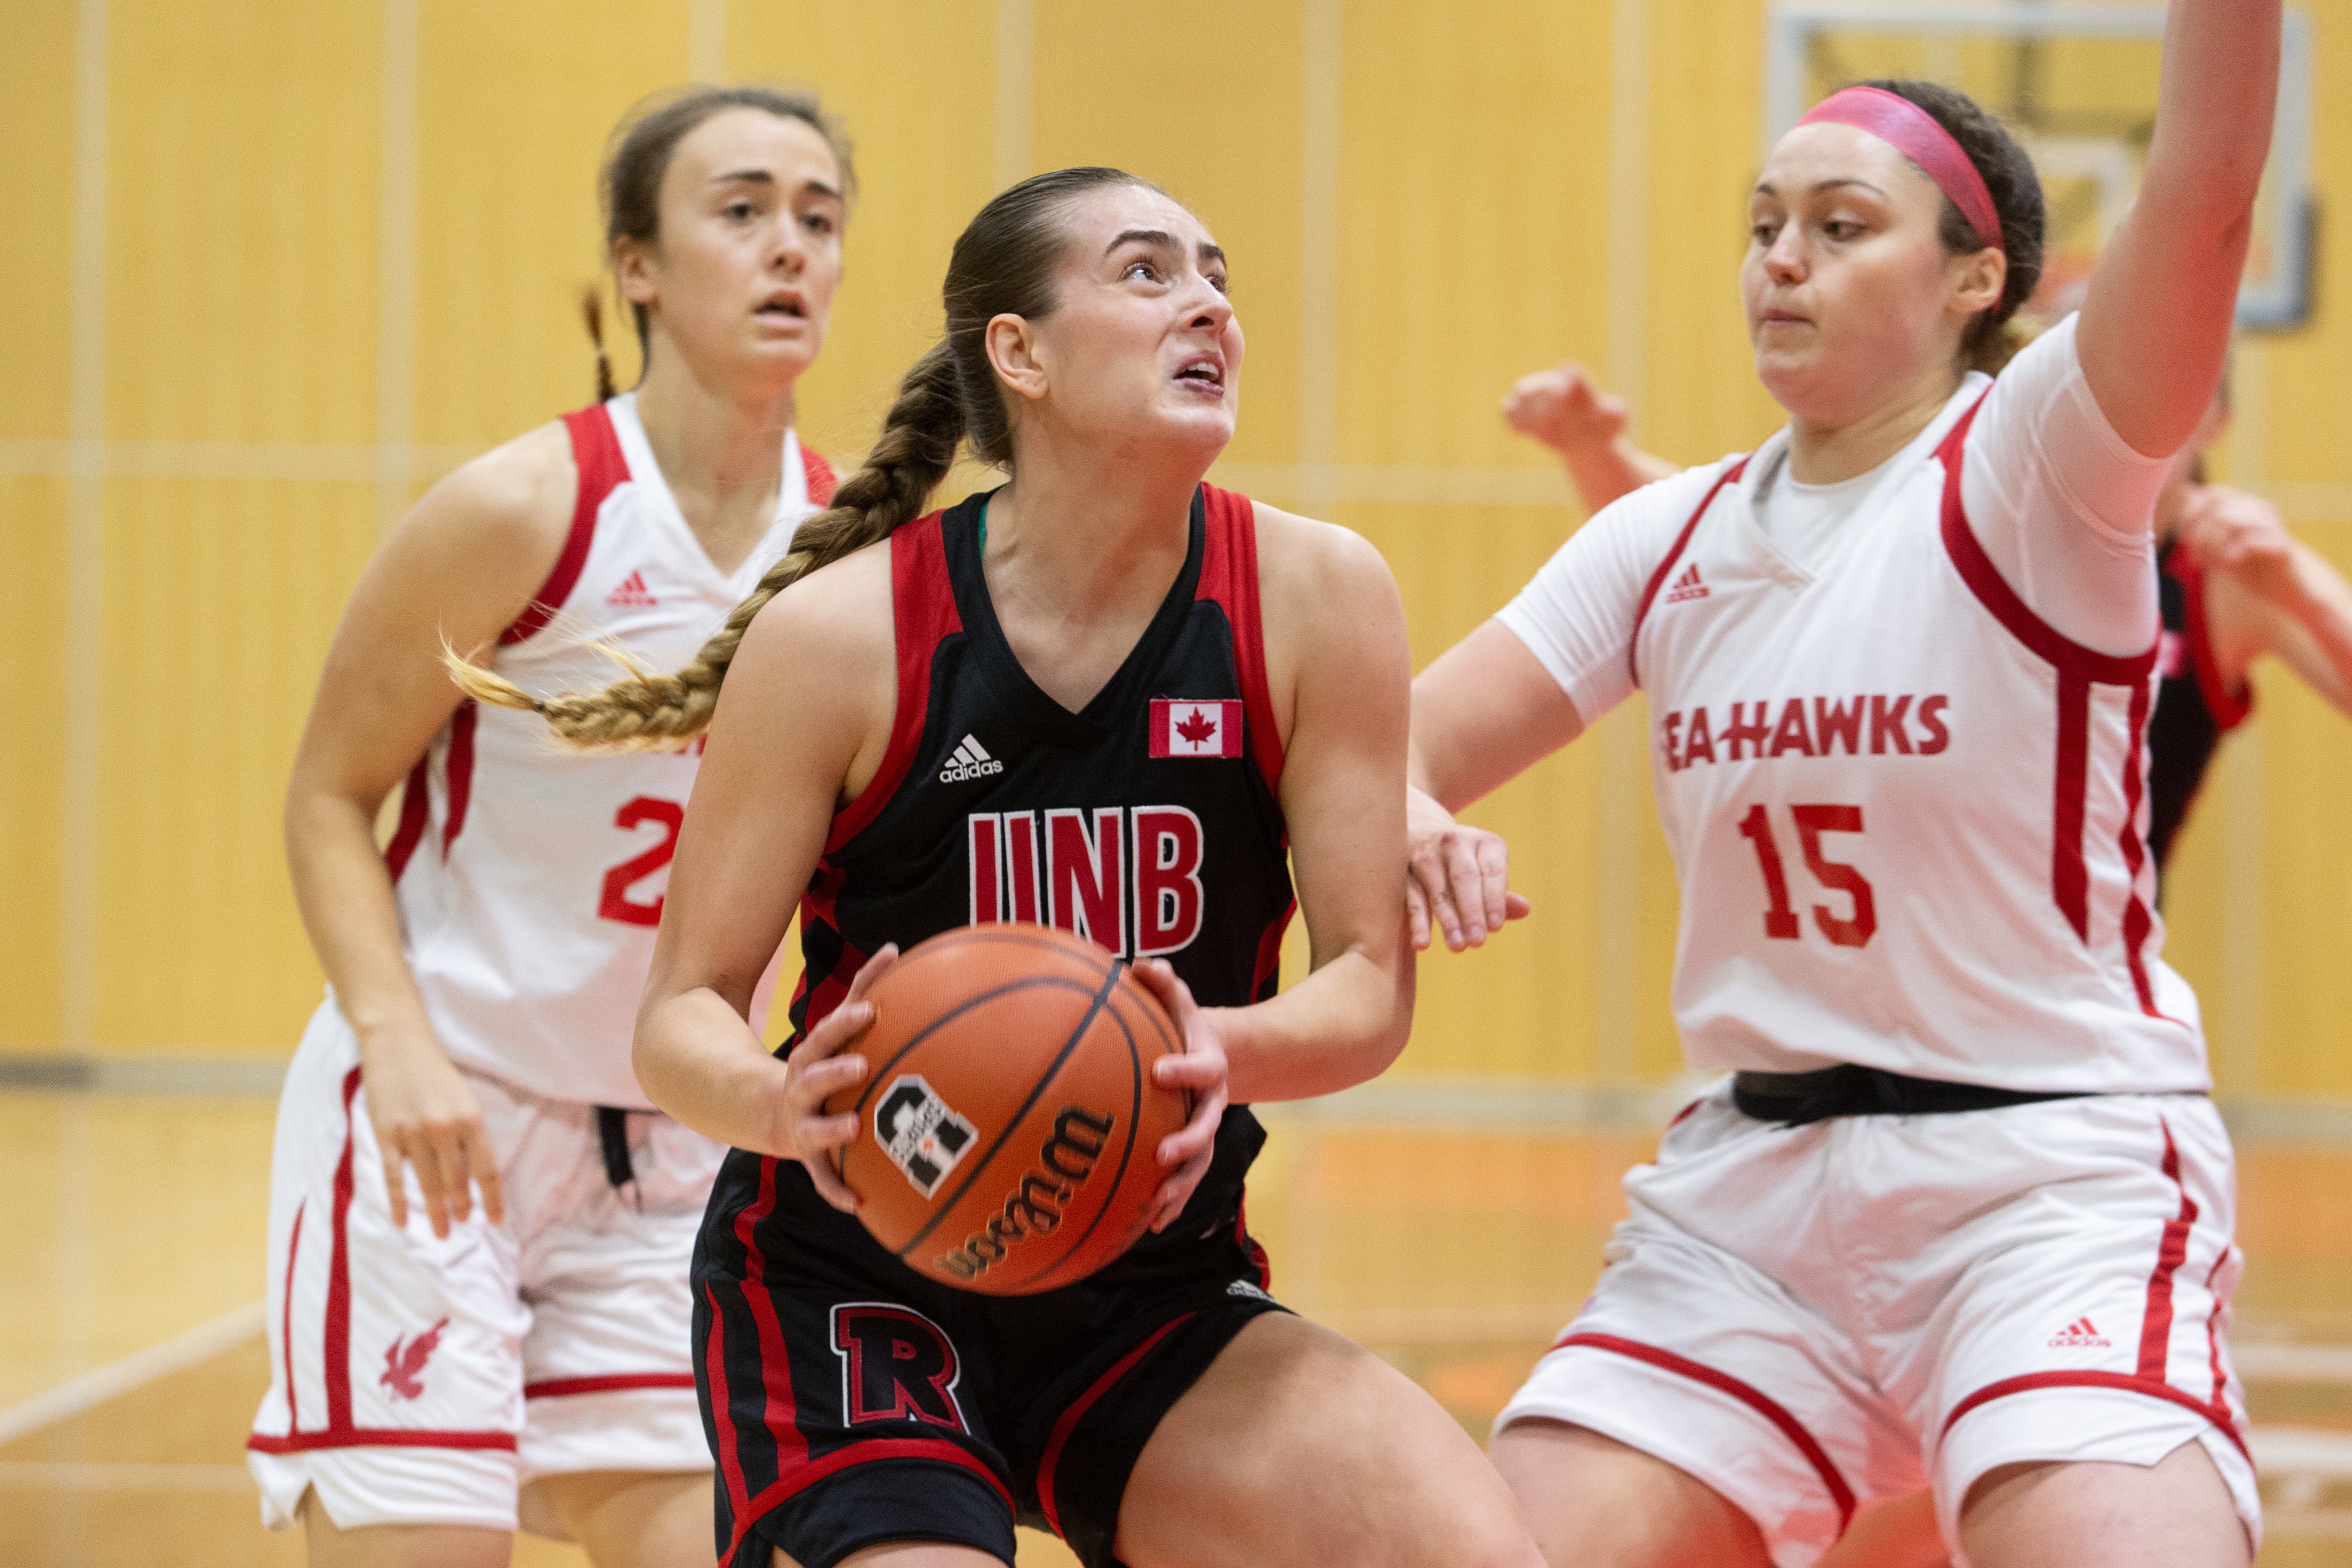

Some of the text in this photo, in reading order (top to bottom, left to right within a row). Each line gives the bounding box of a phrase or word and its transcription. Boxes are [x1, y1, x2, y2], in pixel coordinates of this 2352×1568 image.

[939, 760, 1004, 784] adidas
[1661, 694, 1951, 773] EAHAWKS
[968, 804, 1204, 959] UNB
[1736, 803, 1879, 949] 15
[934, 1103, 1115, 1279] Wilson
[829, 1301, 972, 1435] R
